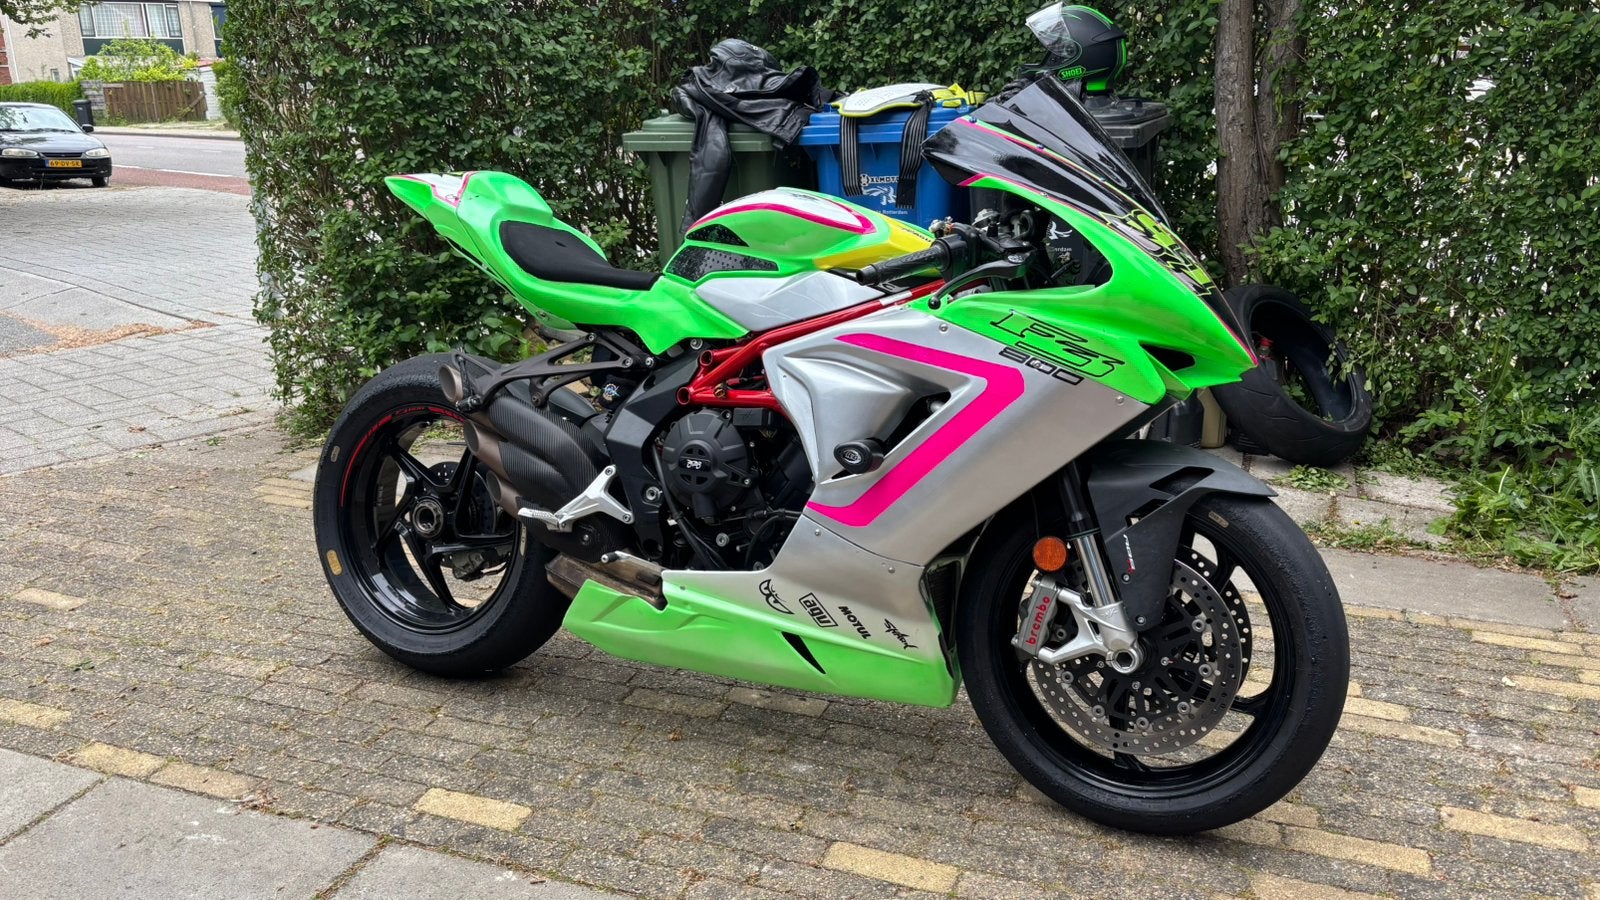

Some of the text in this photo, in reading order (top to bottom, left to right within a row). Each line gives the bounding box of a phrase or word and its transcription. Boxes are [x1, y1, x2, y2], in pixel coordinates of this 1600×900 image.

[1061, 68, 1083, 78] SHOEI
[989, 309, 1125, 378] F3
[998, 346, 1085, 386] 800
[838, 606, 872, 640] MOTUL
[1026, 596, 1051, 645] brembo
